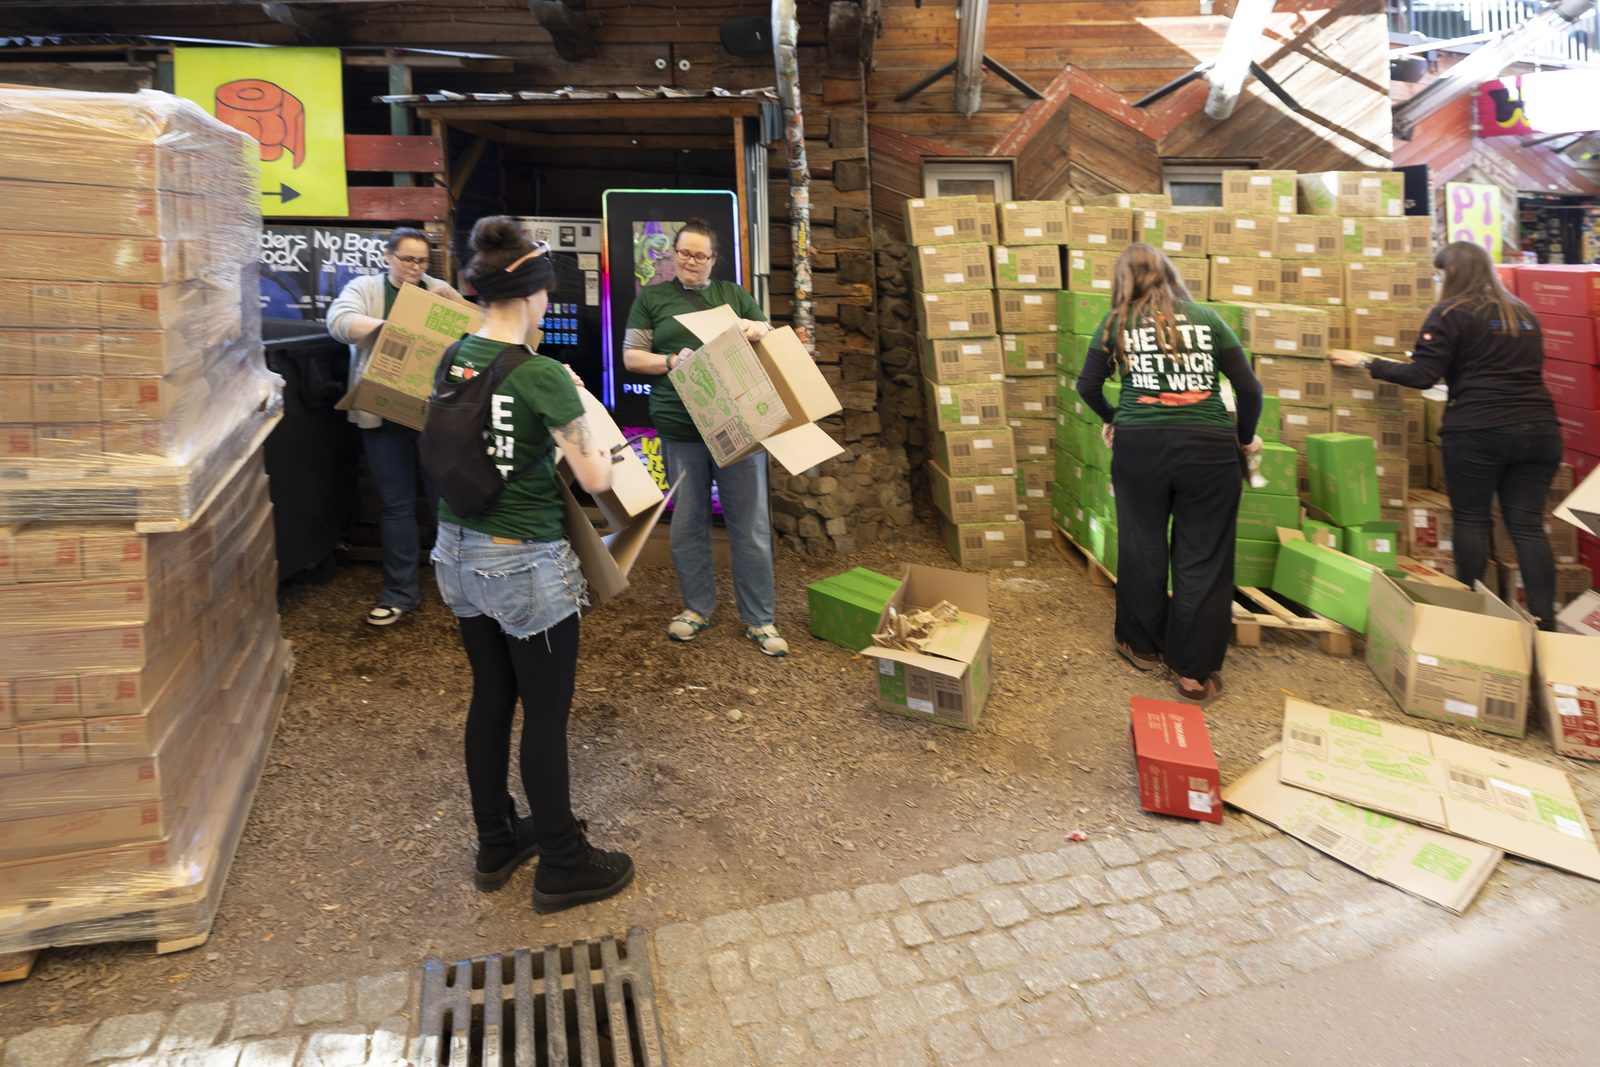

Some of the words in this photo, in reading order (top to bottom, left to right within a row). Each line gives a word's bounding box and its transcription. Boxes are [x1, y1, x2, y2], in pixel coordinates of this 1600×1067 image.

[313, 228, 341, 250] No
[321, 248, 363, 267] Just
[1132, 373, 1160, 390] DIE
